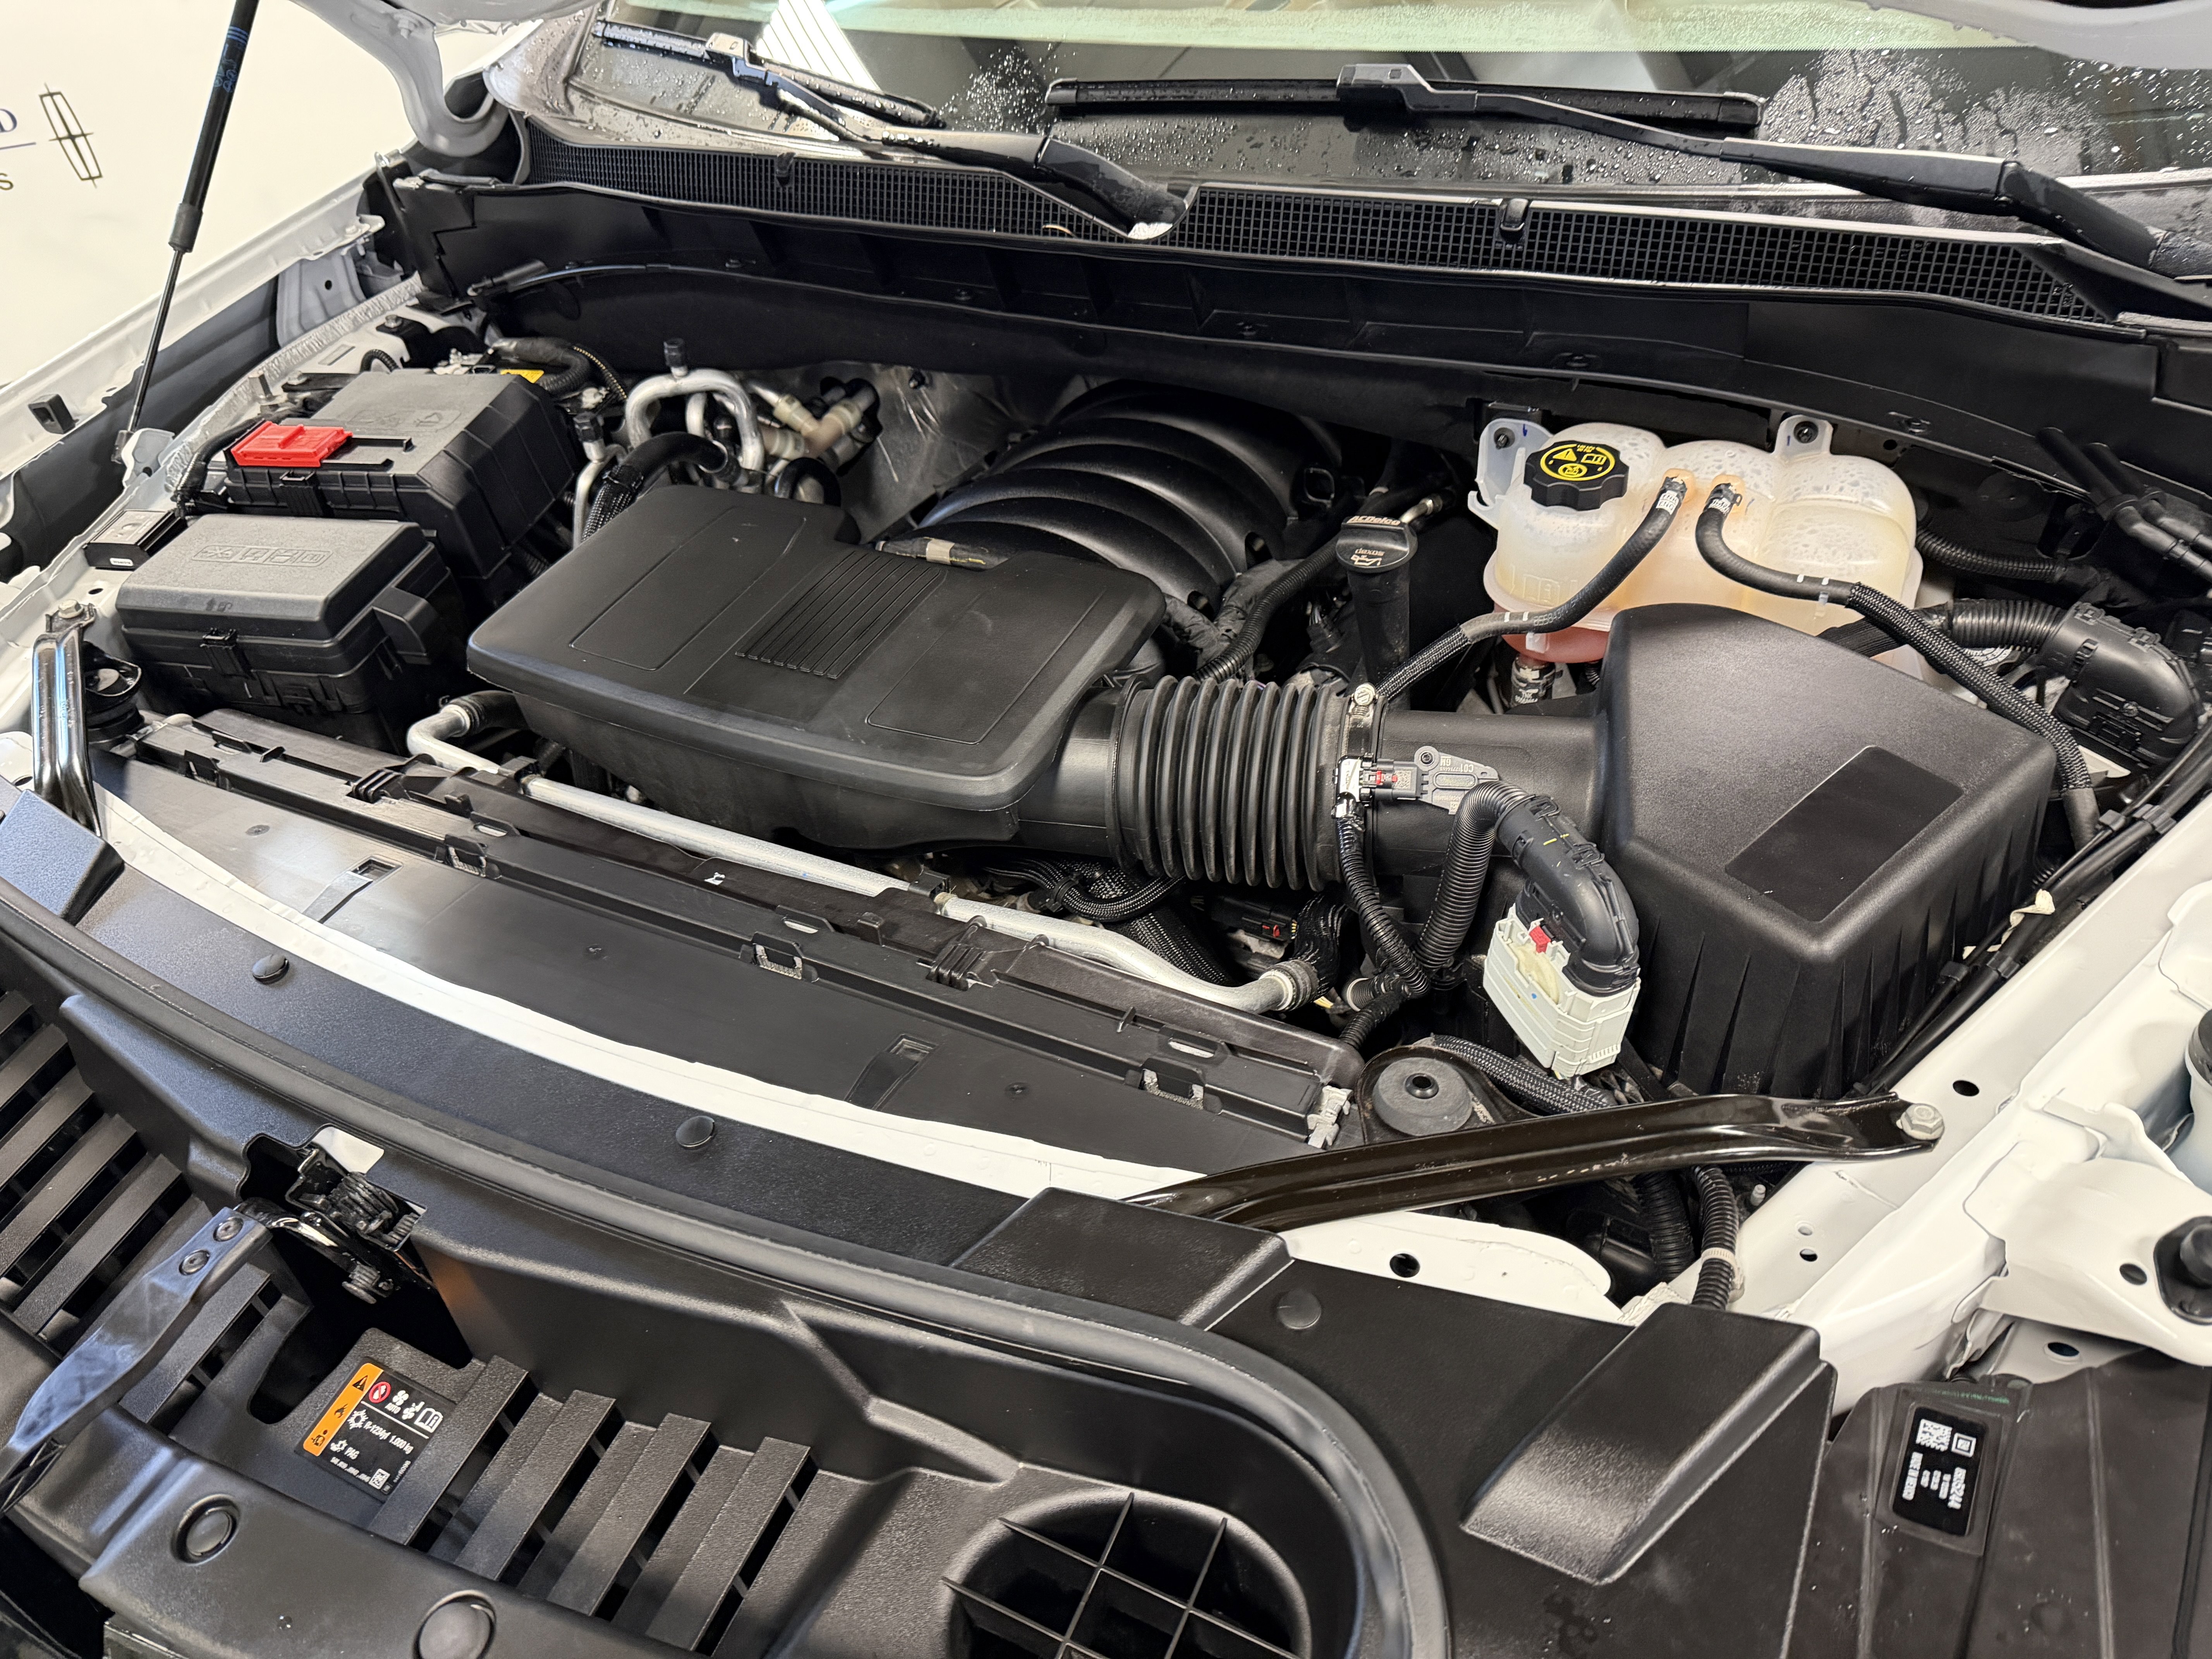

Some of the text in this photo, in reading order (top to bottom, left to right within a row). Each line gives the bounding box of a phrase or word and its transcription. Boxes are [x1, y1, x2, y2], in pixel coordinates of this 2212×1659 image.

[1346, 515, 1400, 526] ACDelco
[1355, 548, 1385, 556] dexos
[1440, 756, 1451, 766] GM
[385, 1402, 401, 1413] AUTO
[363, 1421, 414, 1454] R-1234yf 1.000 kg
[344, 1447, 360, 1460] PAG
